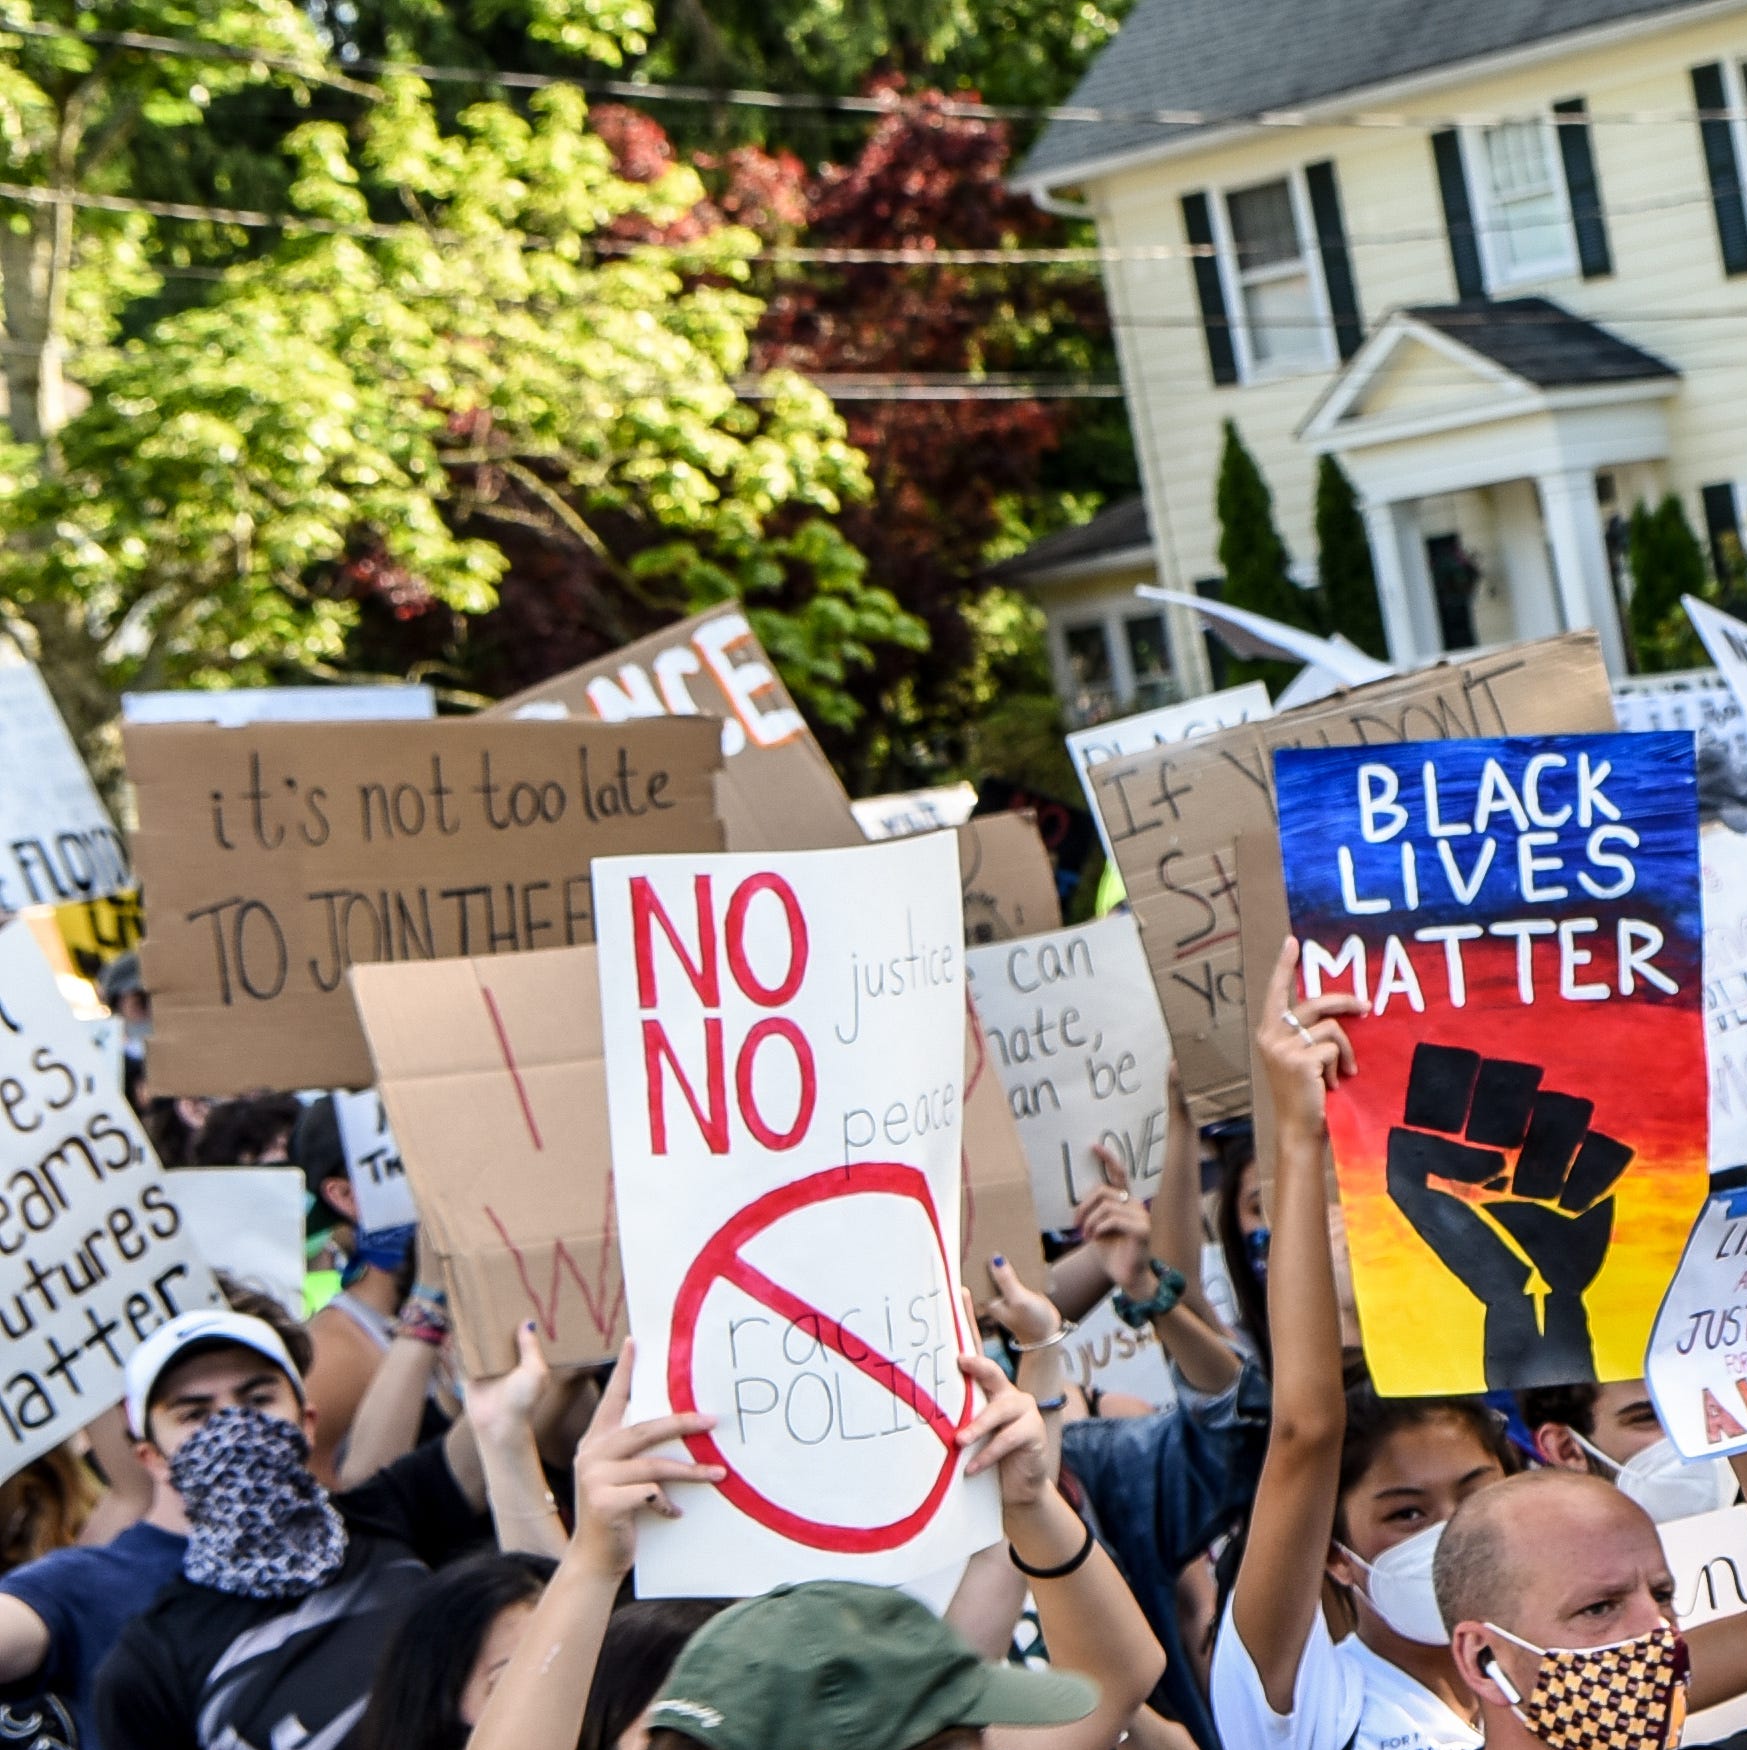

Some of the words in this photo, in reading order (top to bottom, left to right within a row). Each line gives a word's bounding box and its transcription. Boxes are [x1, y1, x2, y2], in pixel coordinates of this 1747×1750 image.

[211, 750, 330, 850] it's
[361, 753, 462, 841] not
[481, 749, 567, 829] too
[581, 746, 678, 825] late
[1102, 759, 1194, 842] If
[1356, 751, 1624, 843] BLACK
[1337, 823, 1641, 915] LIVES
[188, 895, 289, 1008] TO
[308, 885, 432, 995] JOIN
[628, 871, 811, 1010] NO
[834, 905, 954, 1046] justice
[1007, 935, 1095, 995] can
[1302, 916, 1680, 1019] MATTER
[640, 1015, 817, 1157] NO
[843, 1080, 956, 1180] peace
[1086, 1050, 1143, 1100] be
[0, 1180, 181, 1345] utures
[728, 1254, 945, 1370] racist
[733, 1342, 949, 1447] POLICE
